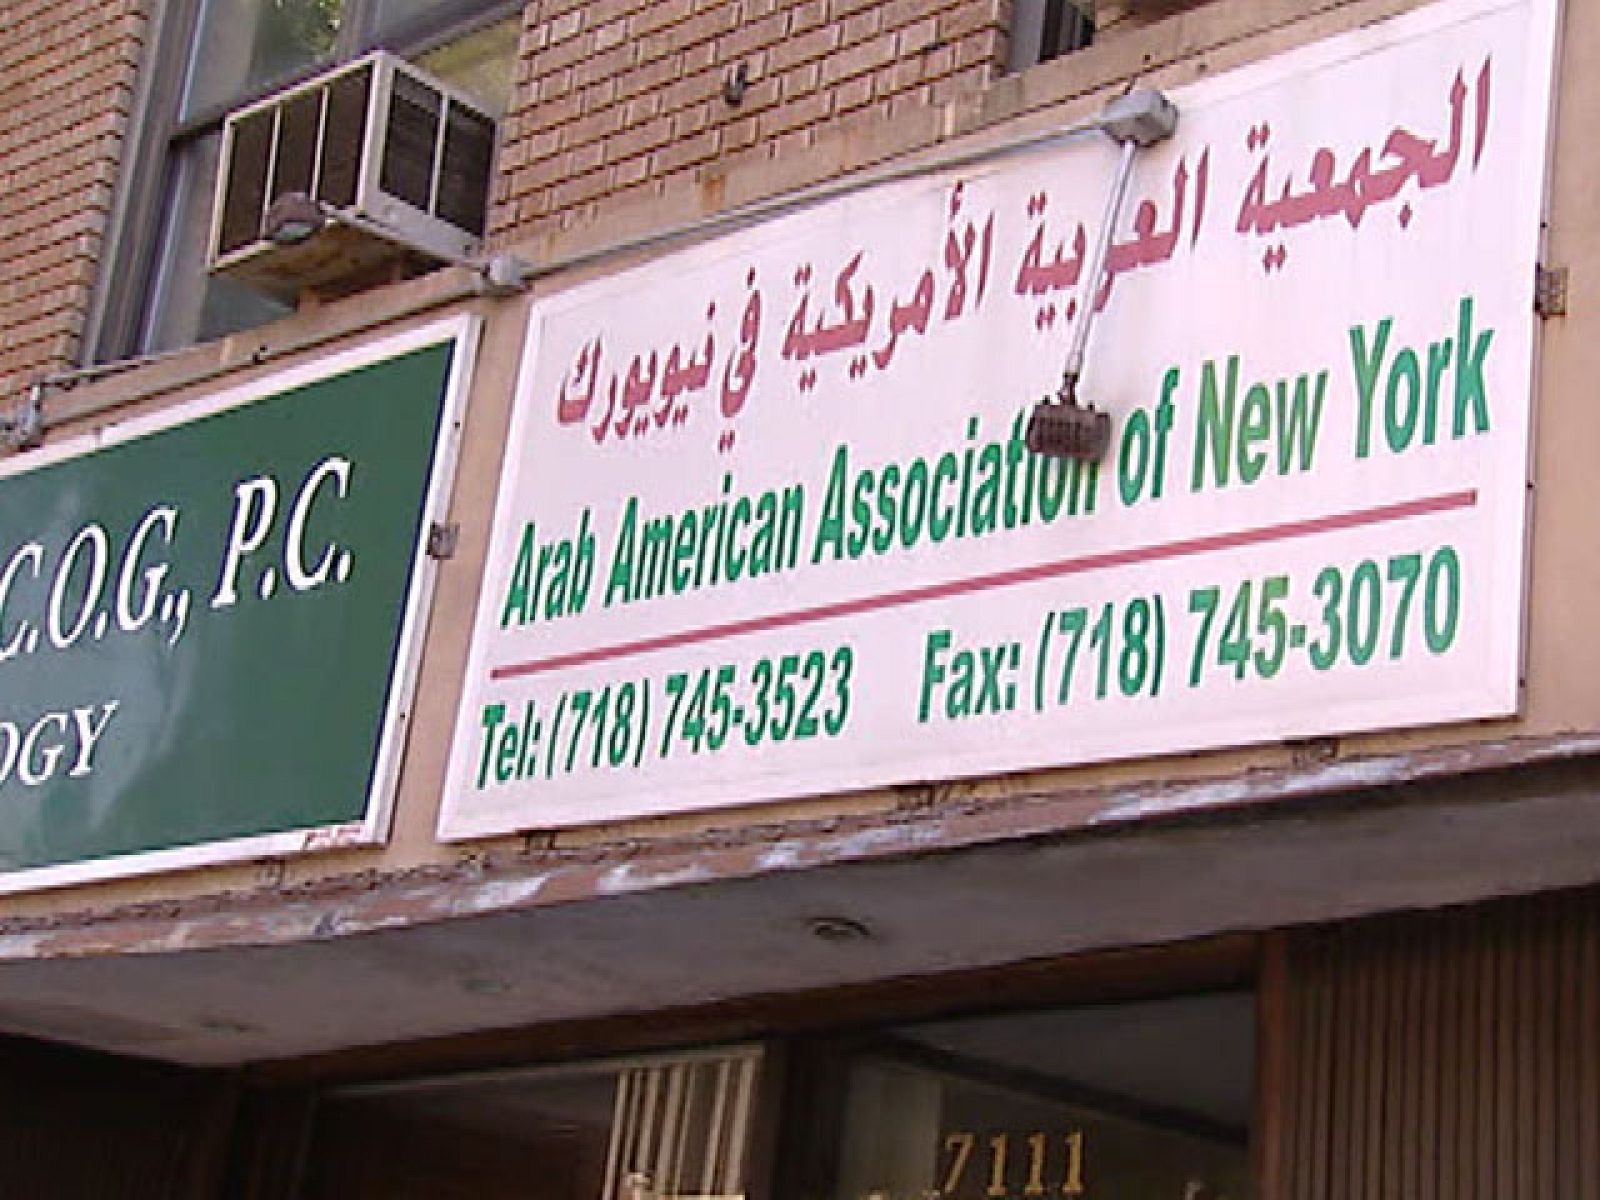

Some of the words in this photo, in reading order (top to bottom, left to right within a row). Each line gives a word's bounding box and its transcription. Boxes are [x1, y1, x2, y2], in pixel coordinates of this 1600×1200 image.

[1014, 144, 1210, 331] العربية
[1236, 54, 1491, 273] الجمعية
[557, 301, 717, 443] نيويورك
[720, 266, 762, 453] في
[781, 180, 995, 390] الأمريكية
[210, 456, 352, 609] P.C.
[500, 507, 597, 628] Arab
[602, 472, 806, 608] American
[810, 406, 1101, 564] Association
[1116, 366, 1182, 506] of
[1189, 354, 1330, 494] New
[1347, 296, 1495, 459] York
[659, 646, 856, 758] 745-3523
[917, 630, 1022, 723] Fax:
[1034, 594, 1167, 713] (718)
[1187, 545, 1462, 687] 745-3070
[942, 1128, 1084, 1197] 7111
